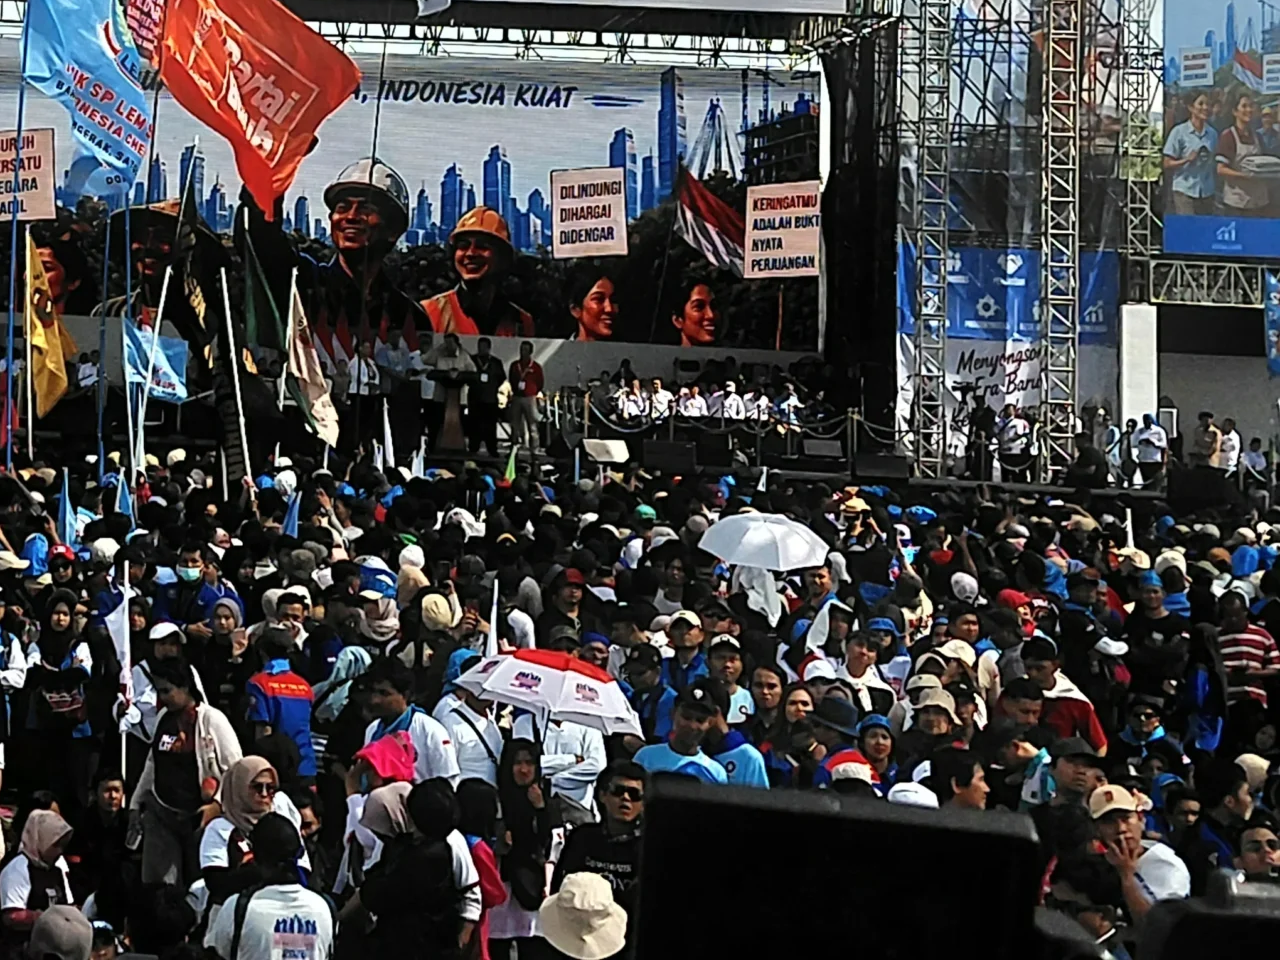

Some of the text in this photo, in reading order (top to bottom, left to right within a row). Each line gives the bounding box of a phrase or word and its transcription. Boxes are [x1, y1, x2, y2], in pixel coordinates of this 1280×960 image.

[378, 79, 506, 106] INDONESIA
[513, 84, 579, 108] KUAT
[89, 81, 115, 104] SP
[115, 99, 148, 130] LEM
[560, 180, 622, 200] DILINDUNGI
[752, 194, 818, 212] KERINGATMU
[559, 204, 612, 223] DIHARGAI
[751, 216, 792, 231] ADALAH
[559, 226, 615, 245] DIDENGAR
[751, 237, 783, 252] NYATA
[751, 255, 815, 273] PERJUANGAN
